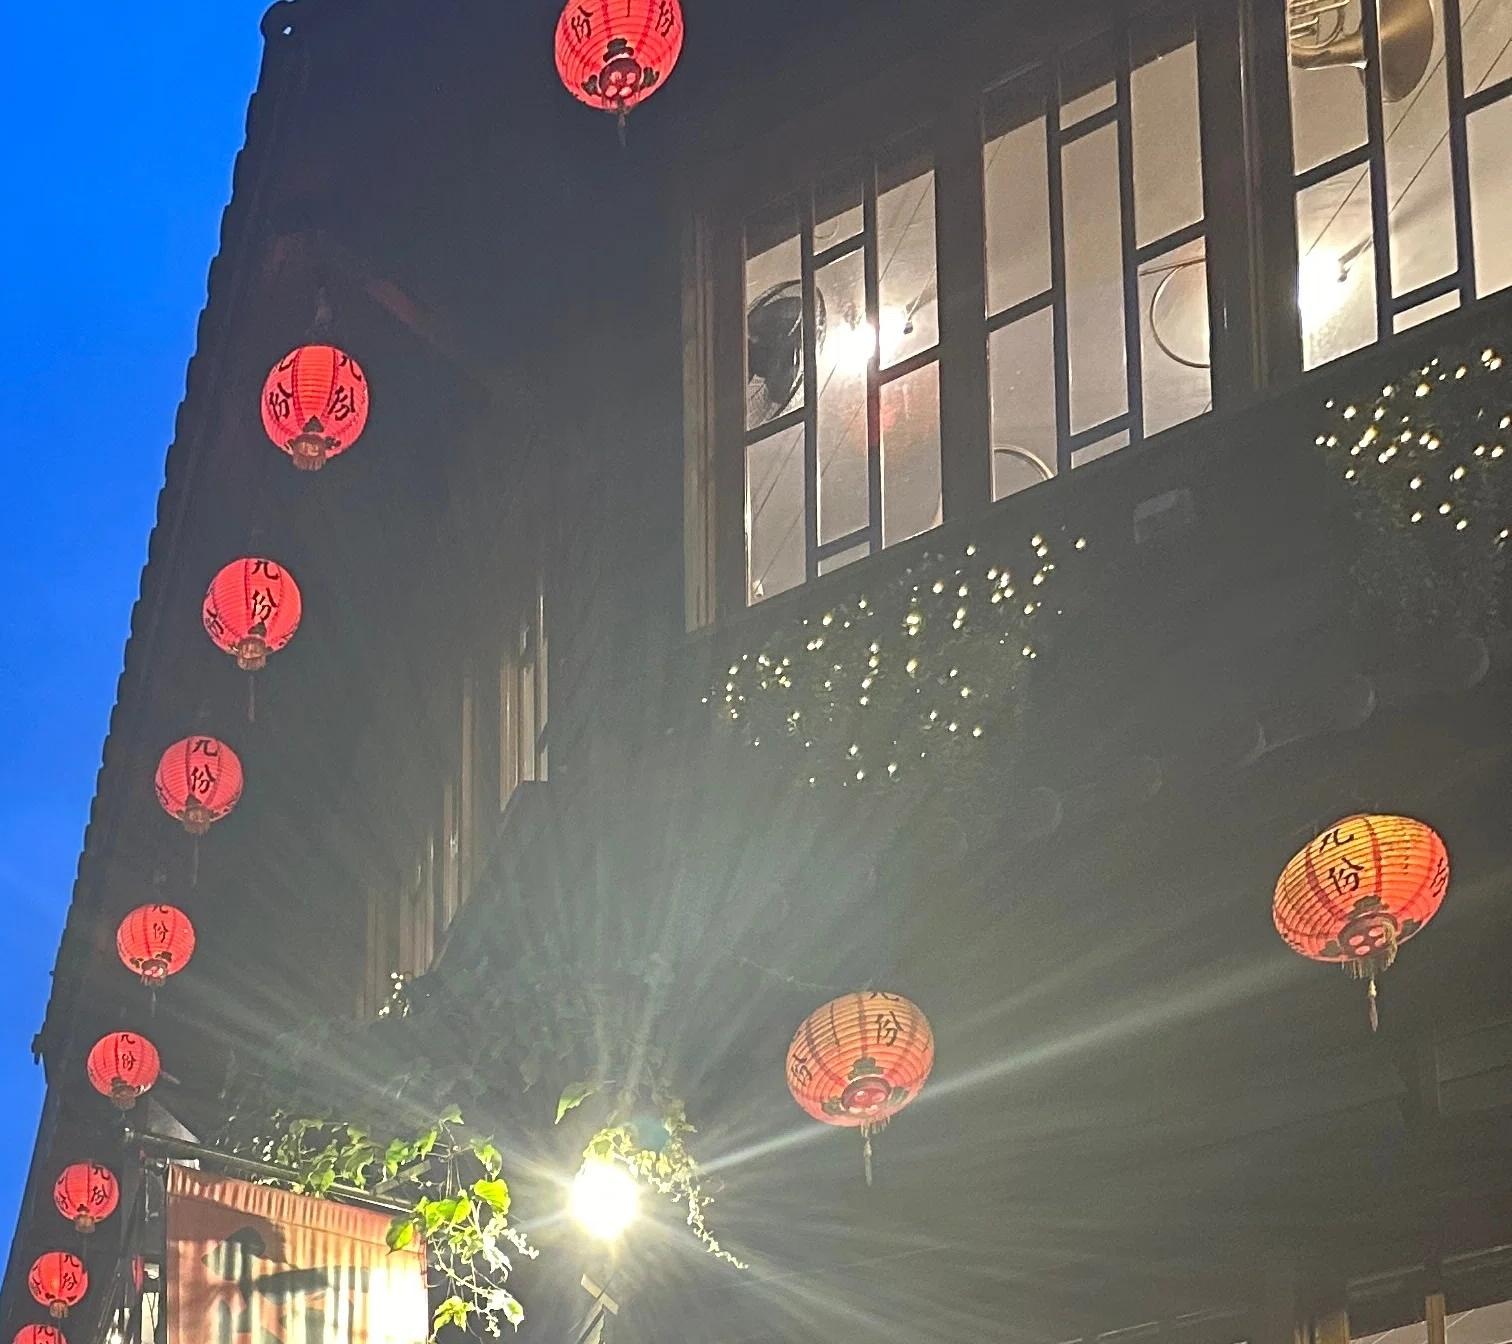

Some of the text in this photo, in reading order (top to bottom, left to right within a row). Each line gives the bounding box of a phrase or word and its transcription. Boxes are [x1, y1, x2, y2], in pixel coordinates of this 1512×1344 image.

[251, 560, 280, 621] 九份
[191, 740, 218, 795] 九份
[1319, 828, 1365, 896] 九份
[121, 1034, 137, 1071] 九份
[91, 1163, 111, 1205] 九份
[62, 1254, 80, 1290] 九份
